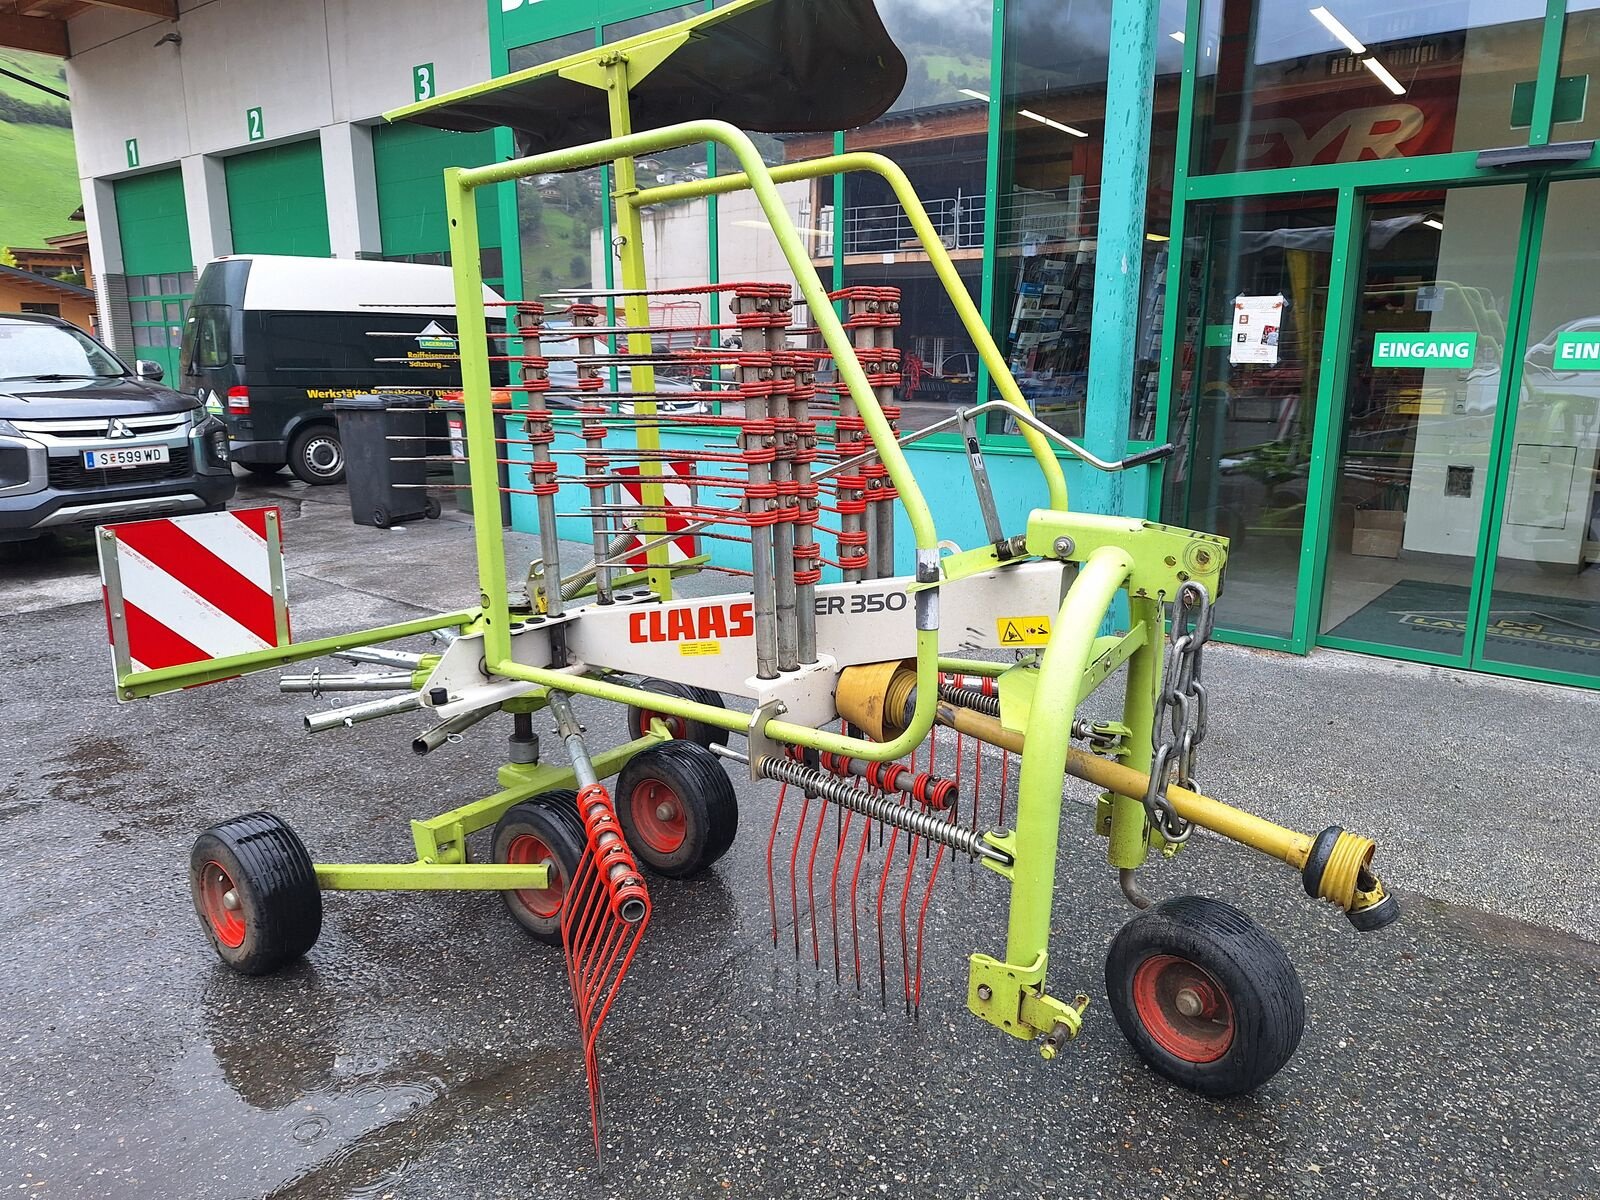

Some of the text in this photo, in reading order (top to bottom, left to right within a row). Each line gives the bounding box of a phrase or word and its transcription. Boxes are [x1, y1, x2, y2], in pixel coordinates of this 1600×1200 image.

[417, 67, 430, 100] 3
[249, 110, 261, 138] 2
[128, 140, 138, 165] 1
[1378, 342, 1469, 358] EINGANG
[1561, 342, 1600, 359] EIN
[850, 591, 907, 614] 350
[629, 602, 754, 643] CLAAS
